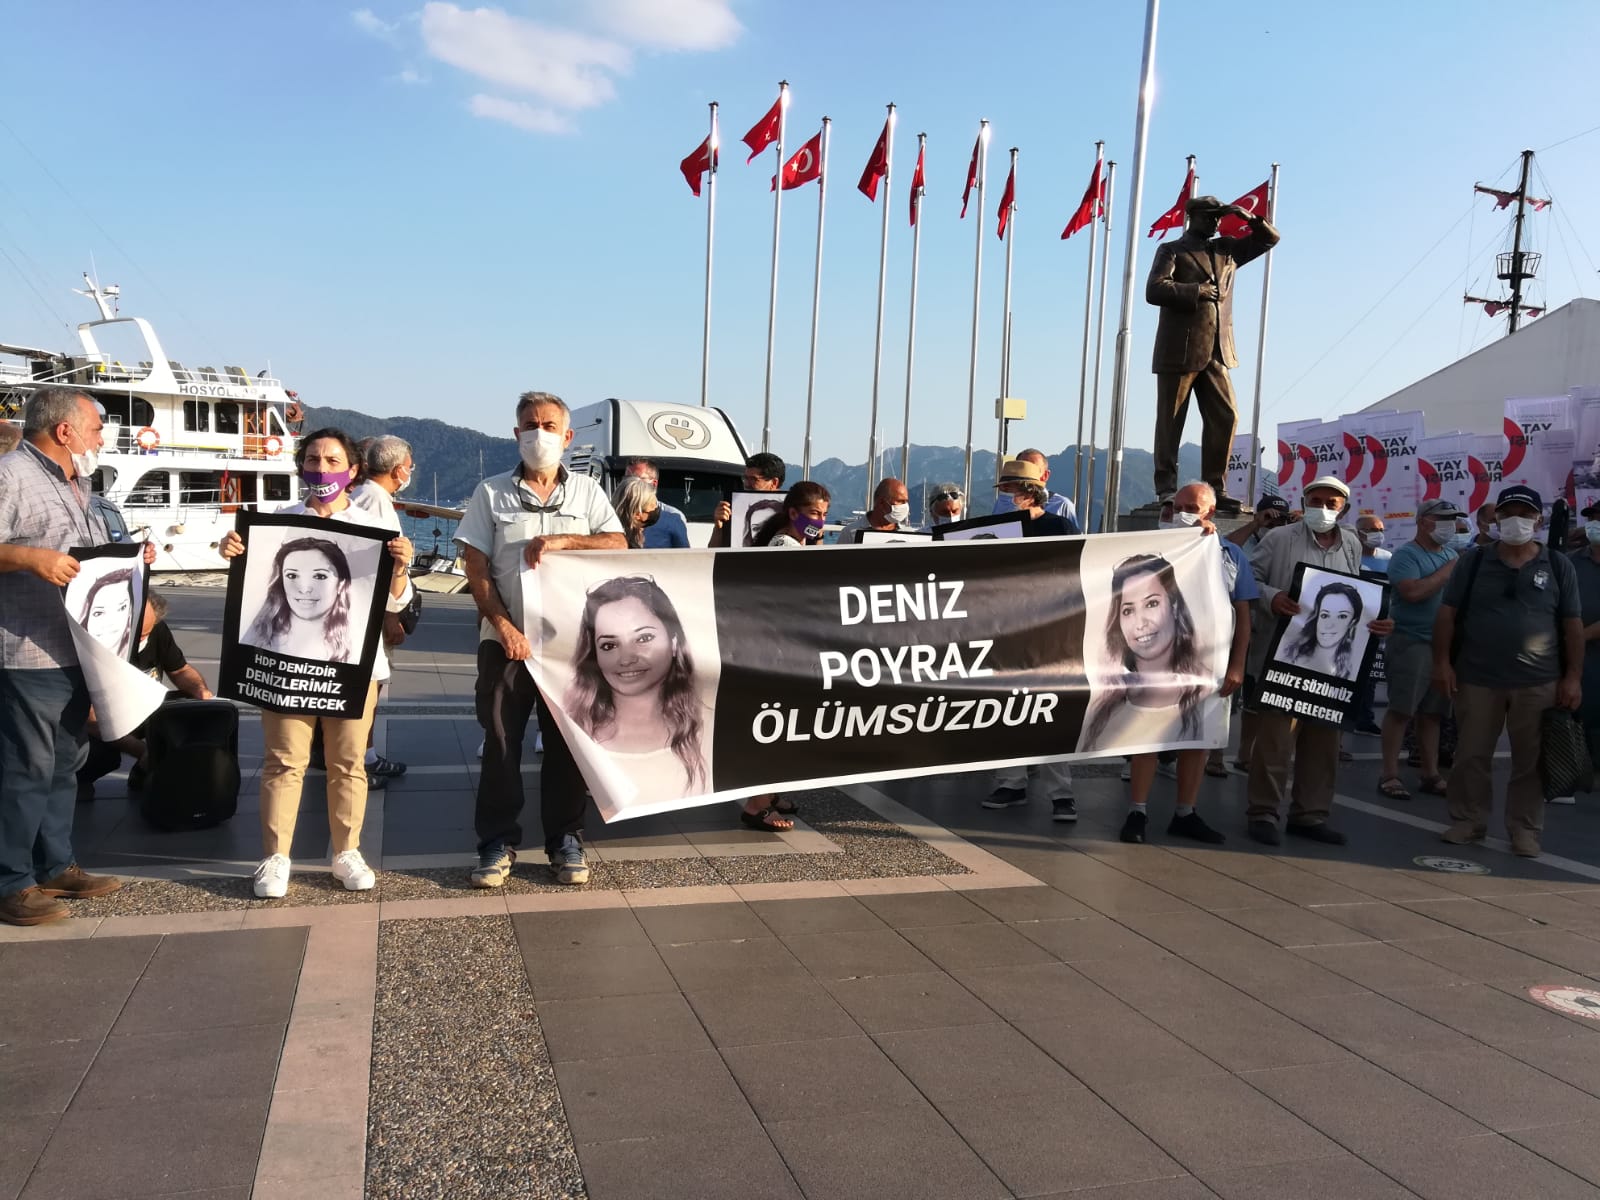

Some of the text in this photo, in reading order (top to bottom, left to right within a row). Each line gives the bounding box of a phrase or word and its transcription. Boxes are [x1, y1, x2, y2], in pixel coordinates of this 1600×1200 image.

[179, 384, 258, 398] HOSYOLA
[838, 573, 968, 626] DENİZ
[254, 654, 337, 678] HDP DENİZDİR
[819, 639, 995, 690] POYRAZ
[245, 667, 343, 694] DENİZLERİMİZ
[1301, 678, 1354, 703] SÖZÜMÜZ
[237, 682, 347, 711] TÜKENMEYECEK
[1260, 691, 1344, 724] BARIŞ GELECEK!
[752, 687, 1059, 744] ÖLÜMSÜZDÜR
